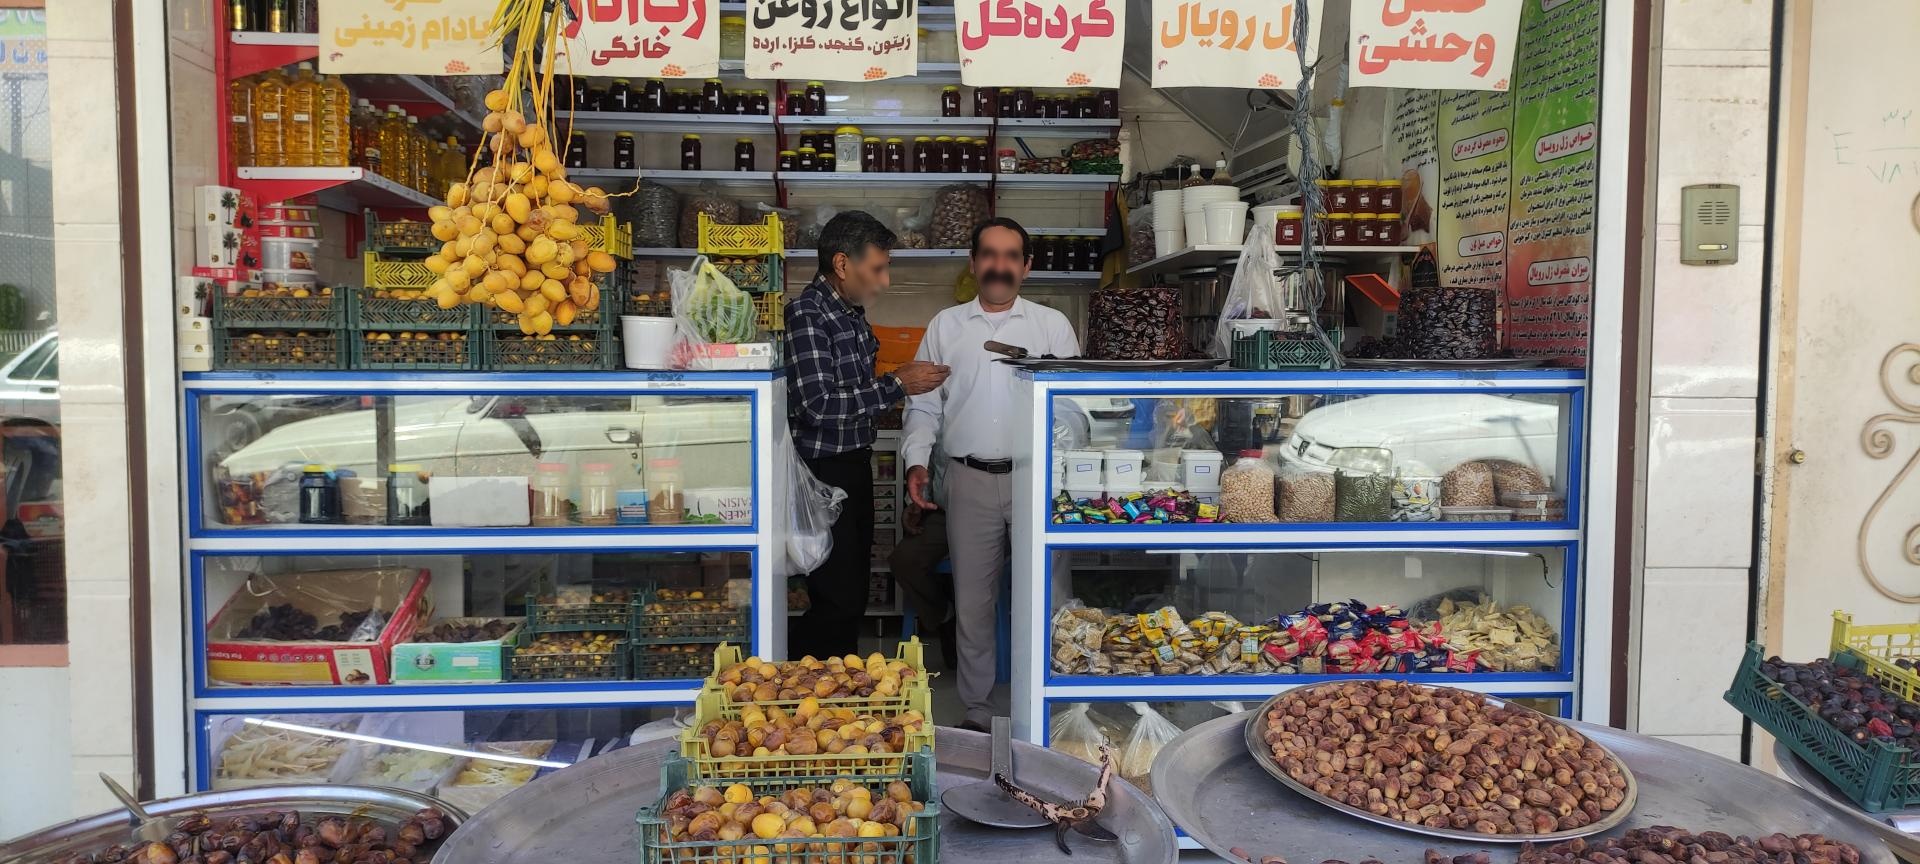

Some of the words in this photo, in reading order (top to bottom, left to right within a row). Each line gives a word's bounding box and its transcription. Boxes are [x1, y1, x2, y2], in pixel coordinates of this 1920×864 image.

[753, 0, 834, 29] روغن
[840, 0, 912, 31] انواع
[335, 14, 416, 47] زمینی
[422, 15, 491, 51] بادام
[1161, 2, 1256, 51] رویال
[1263, 5, 1297, 52] ل
[591, 35, 671, 66] خانگی
[753, 36, 779, 53] ارده
[1359, 18, 1495, 78] وحشی
[1477, 138, 1491, 150] مصرف
[1492, 134, 1505, 146] نحوه
[1560, 135, 1568, 151] ژل
[1570, 128, 1592, 148] خواص
[1538, 141, 1559, 156] رویال
[1486, 234, 1502, 248] خواص
[1530, 267, 1544, 281] رویال
[1545, 265, 1553, 279] ژل
[1554, 264, 1570, 279] مصرف
[1571, 263, 1588, 278] میزان
